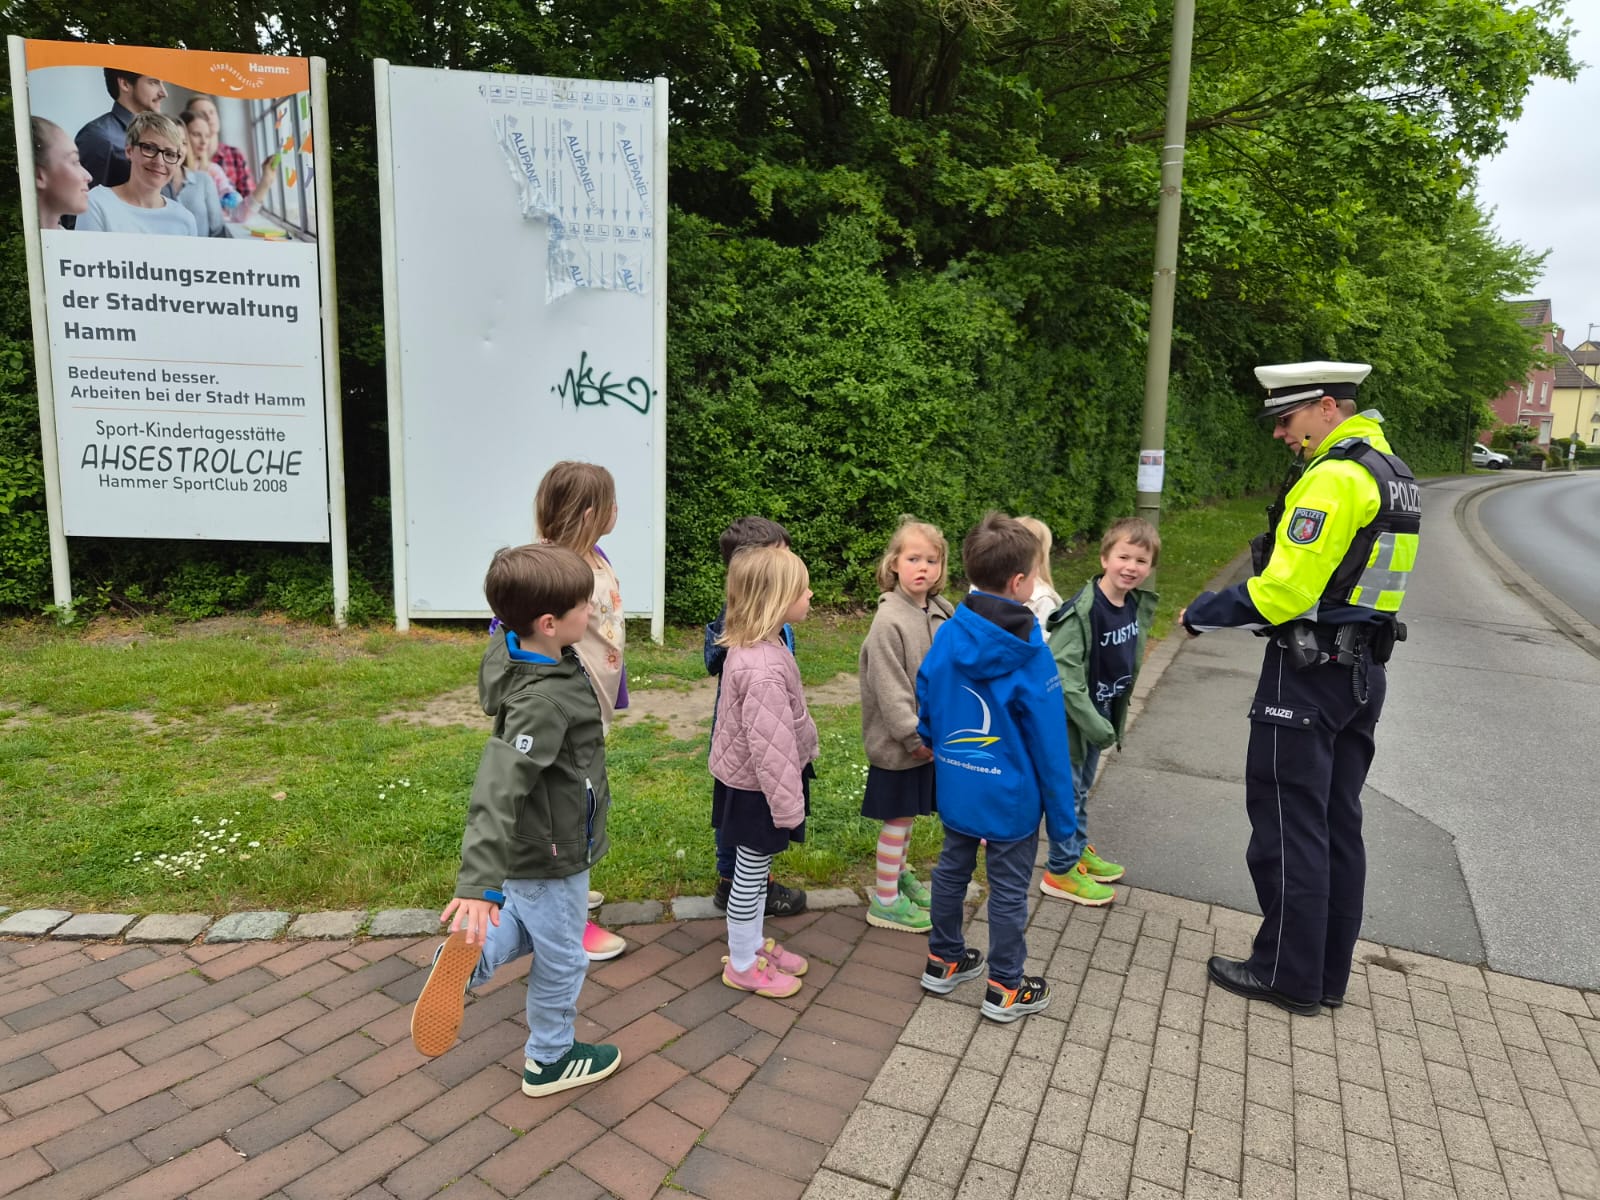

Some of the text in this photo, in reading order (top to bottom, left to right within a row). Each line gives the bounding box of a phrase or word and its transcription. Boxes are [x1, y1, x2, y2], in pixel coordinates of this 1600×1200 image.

[249, 62, 290, 75] Hamm:
[567, 135, 596, 198] ALUPANEL
[620, 138, 649, 201] ALUPANEL
[59, 259, 301, 288] Fortbildungszentrum
[62, 290, 299, 323] der Stadtverwaltung
[64, 322, 137, 342] Hamm
[68, 366, 220, 385] Bedeutend besser.
[70, 385, 306, 407] Arbeiten bei der Stadt Hamm
[95, 419, 286, 444] Sport-Kindertagesstätte
[81, 444, 303, 476] AHSESTROLCHE
[99, 474, 288, 494] Hammer SportClub 2008
[1264, 706, 1294, 719] POLIZEI
